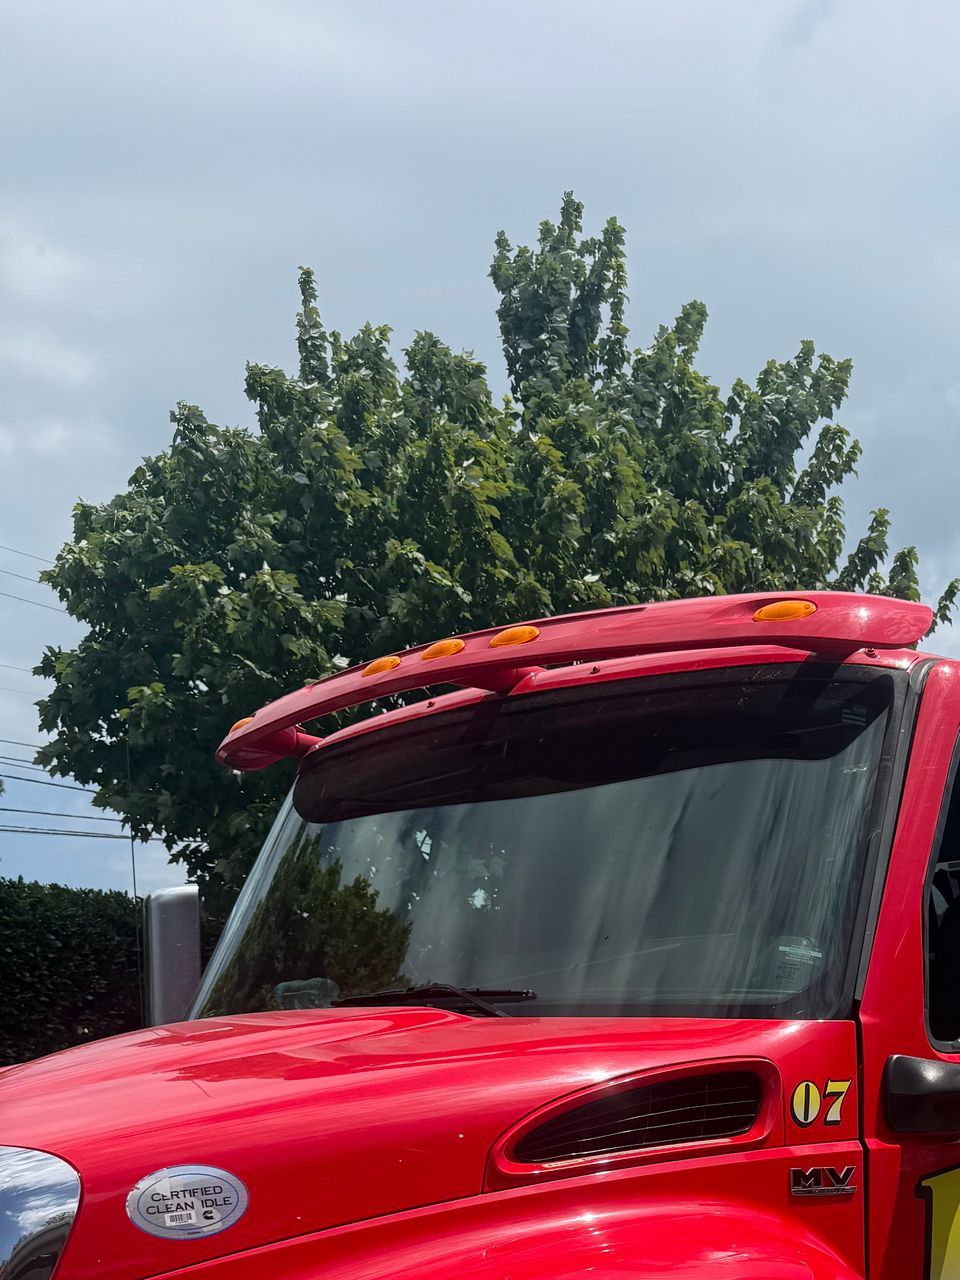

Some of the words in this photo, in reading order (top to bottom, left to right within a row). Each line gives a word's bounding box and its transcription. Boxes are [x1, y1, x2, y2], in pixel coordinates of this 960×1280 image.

[790, 1077, 852, 1129] 07
[790, 1165, 857, 1188] MV
[151, 1185, 223, 1202] CERTIFIED
[146, 1201, 195, 1215] CLEAN
[201, 1196, 232, 1208] IDLE
